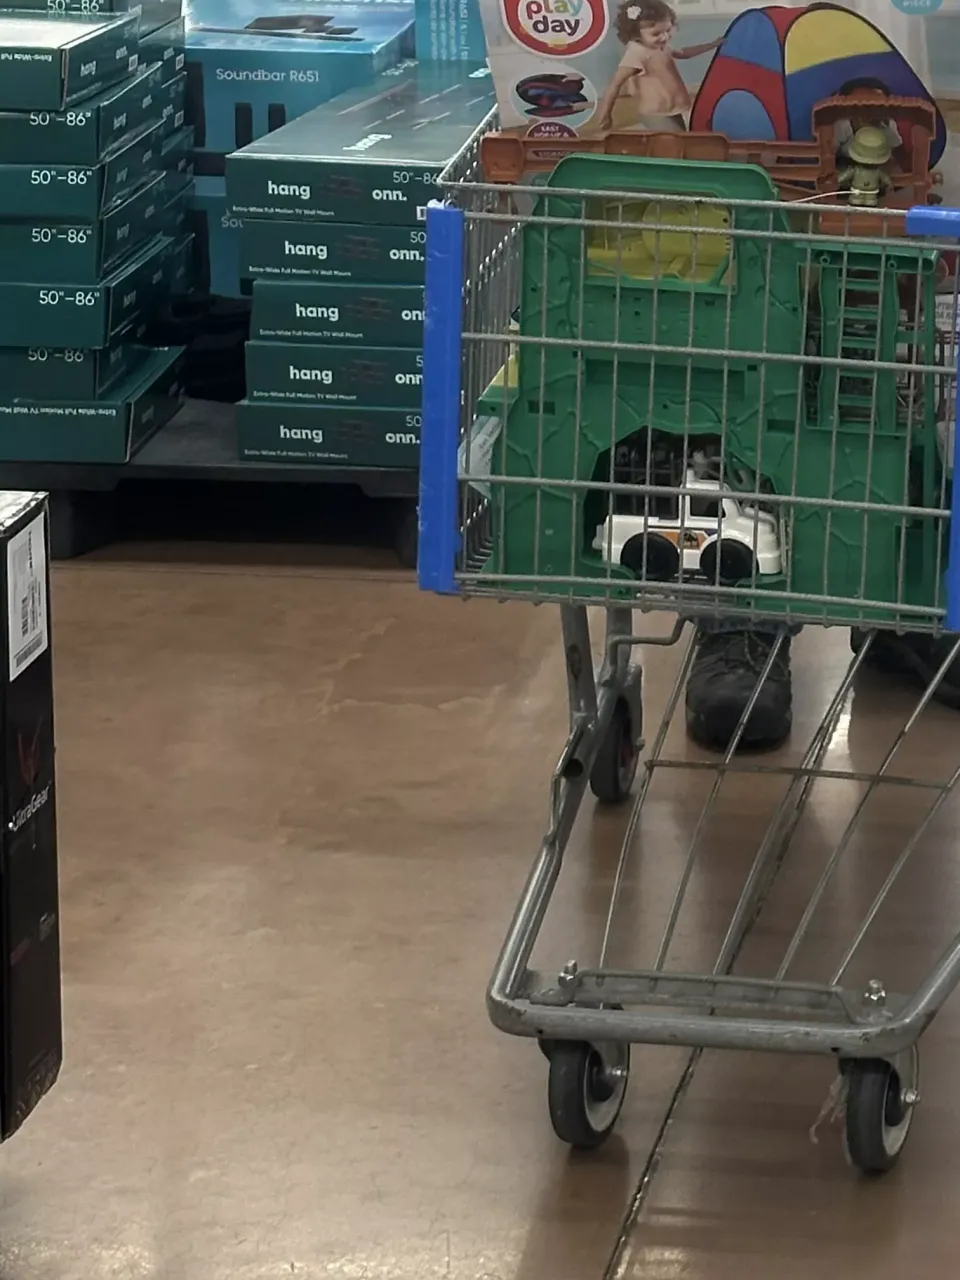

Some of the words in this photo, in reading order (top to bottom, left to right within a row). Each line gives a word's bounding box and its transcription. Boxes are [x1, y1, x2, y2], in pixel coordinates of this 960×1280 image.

[532, 15, 581, 37] day
[216, 68, 287, 83] Soundbar
[290, 69, 319, 83] R651
[393, 171, 438, 185] 50"-86
[268, 180, 311, 200] hang
[372, 188, 408, 202] onn.
[284, 240, 328, 260] hang
[389, 249, 425, 262] onn.
[295, 303, 339, 322] hang
[401, 310, 425, 322] on
[289, 365, 333, 384] hang
[395, 373, 424, 385] onn
[29, 407, 39, 415] TV
[64, 407, 77, 416] Full
[78, 408, 117, 417] Extra-Wide
[279, 424, 323, 444] hang
[385, 432, 421, 445] onn.
